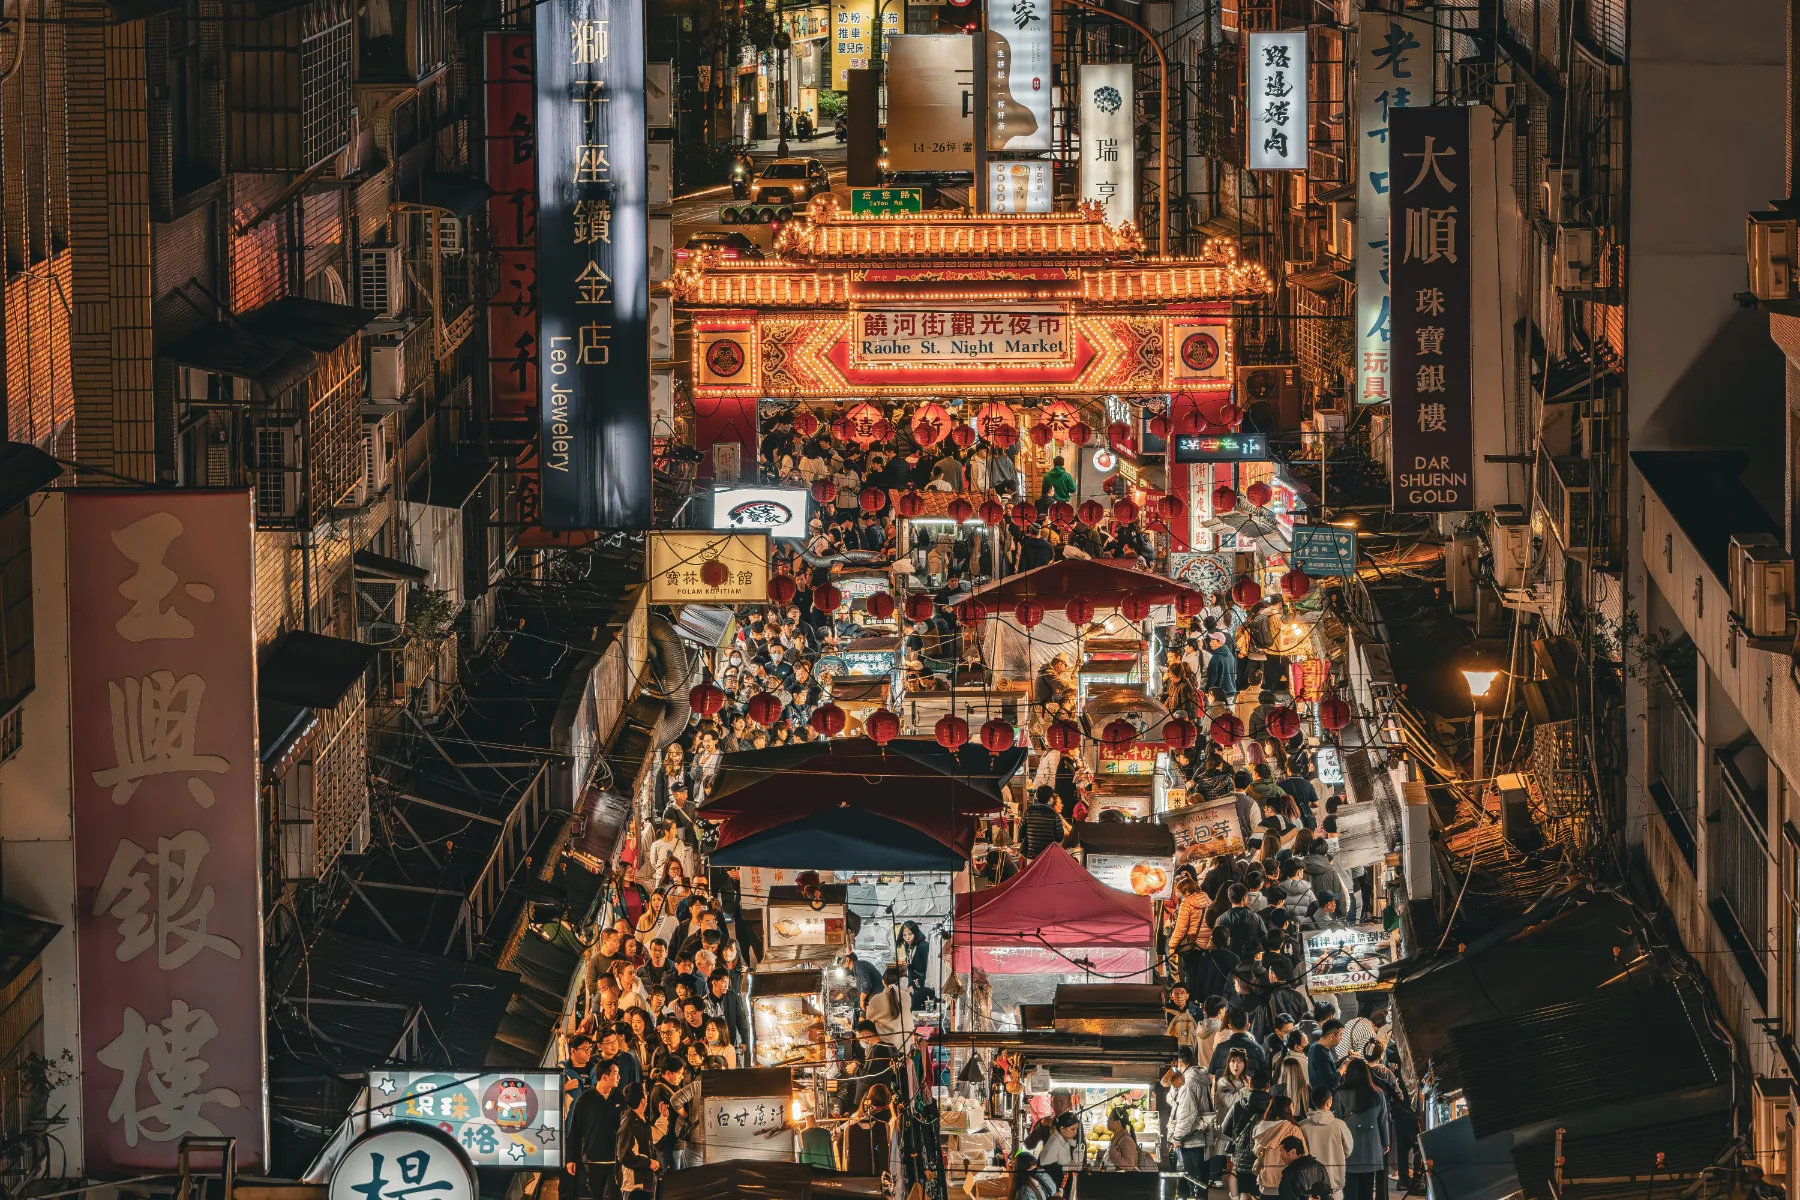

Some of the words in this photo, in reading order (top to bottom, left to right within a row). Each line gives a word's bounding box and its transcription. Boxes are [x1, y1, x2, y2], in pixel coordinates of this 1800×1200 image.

[1259, 45, 1294, 159] 路邊烤肉
[571, 19, 612, 365] 獅子座鑽金店
[862, 313, 1061, 338] 饒河街觀光夜市
[550, 335, 572, 375] Leo
[861, 340, 911, 355] Raohe
[920, 340, 941, 355] St.
[951, 340, 995, 358] Night
[1005, 339, 1064, 354] Market
[1362, 352, 1390, 399] 玩具
[546, 382, 574, 473] Jewelery
[1399, 472, 1468, 488] SHUENN
[1414, 456, 1451, 470] DAR
[1408, 489, 1459, 504] GOLD
[91, 511, 243, 1148] 玉興銀樓
